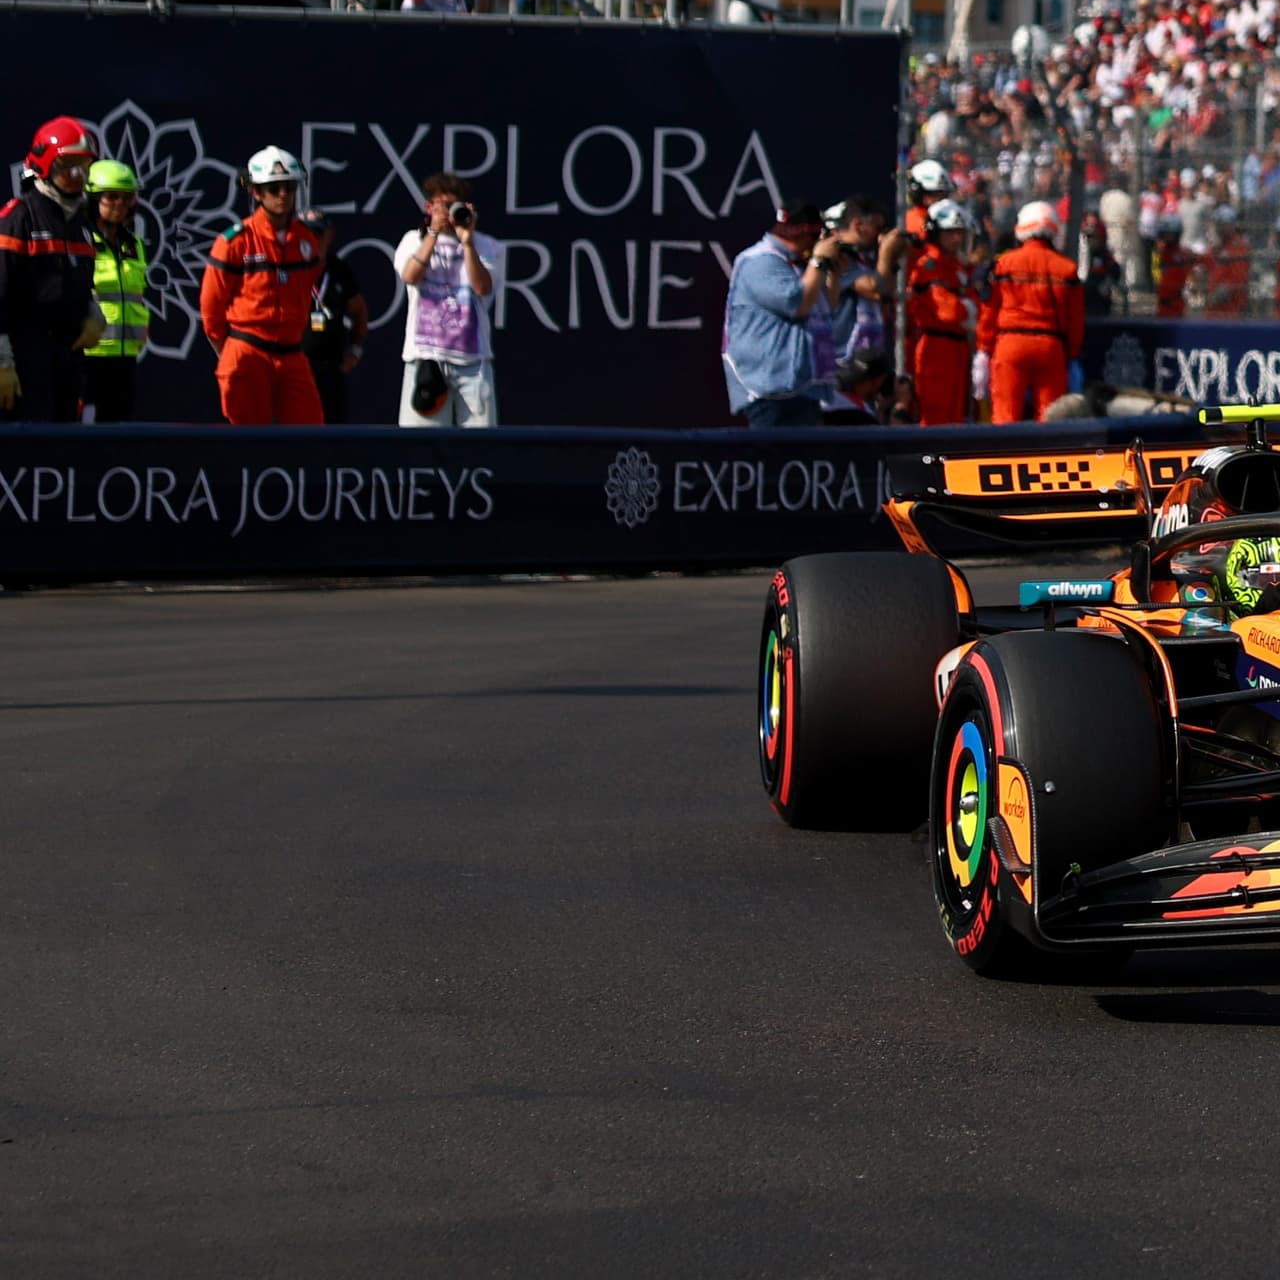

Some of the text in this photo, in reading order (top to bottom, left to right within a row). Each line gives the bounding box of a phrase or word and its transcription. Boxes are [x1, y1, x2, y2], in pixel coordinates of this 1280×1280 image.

[301, 122, 783, 219] EXPLORA
[336, 238, 734, 332] ORNE
[0, 466, 494, 537] XPLORA JOURNEYS
[674, 460, 864, 512] EXPLORA
[978, 460, 1092, 492] OKX
[1048, 581, 1103, 598] allwyn
[1247, 626, 1280, 655] RICHARD
[1004, 799, 1026, 824] workday
[956, 887, 993, 955] ZERO
